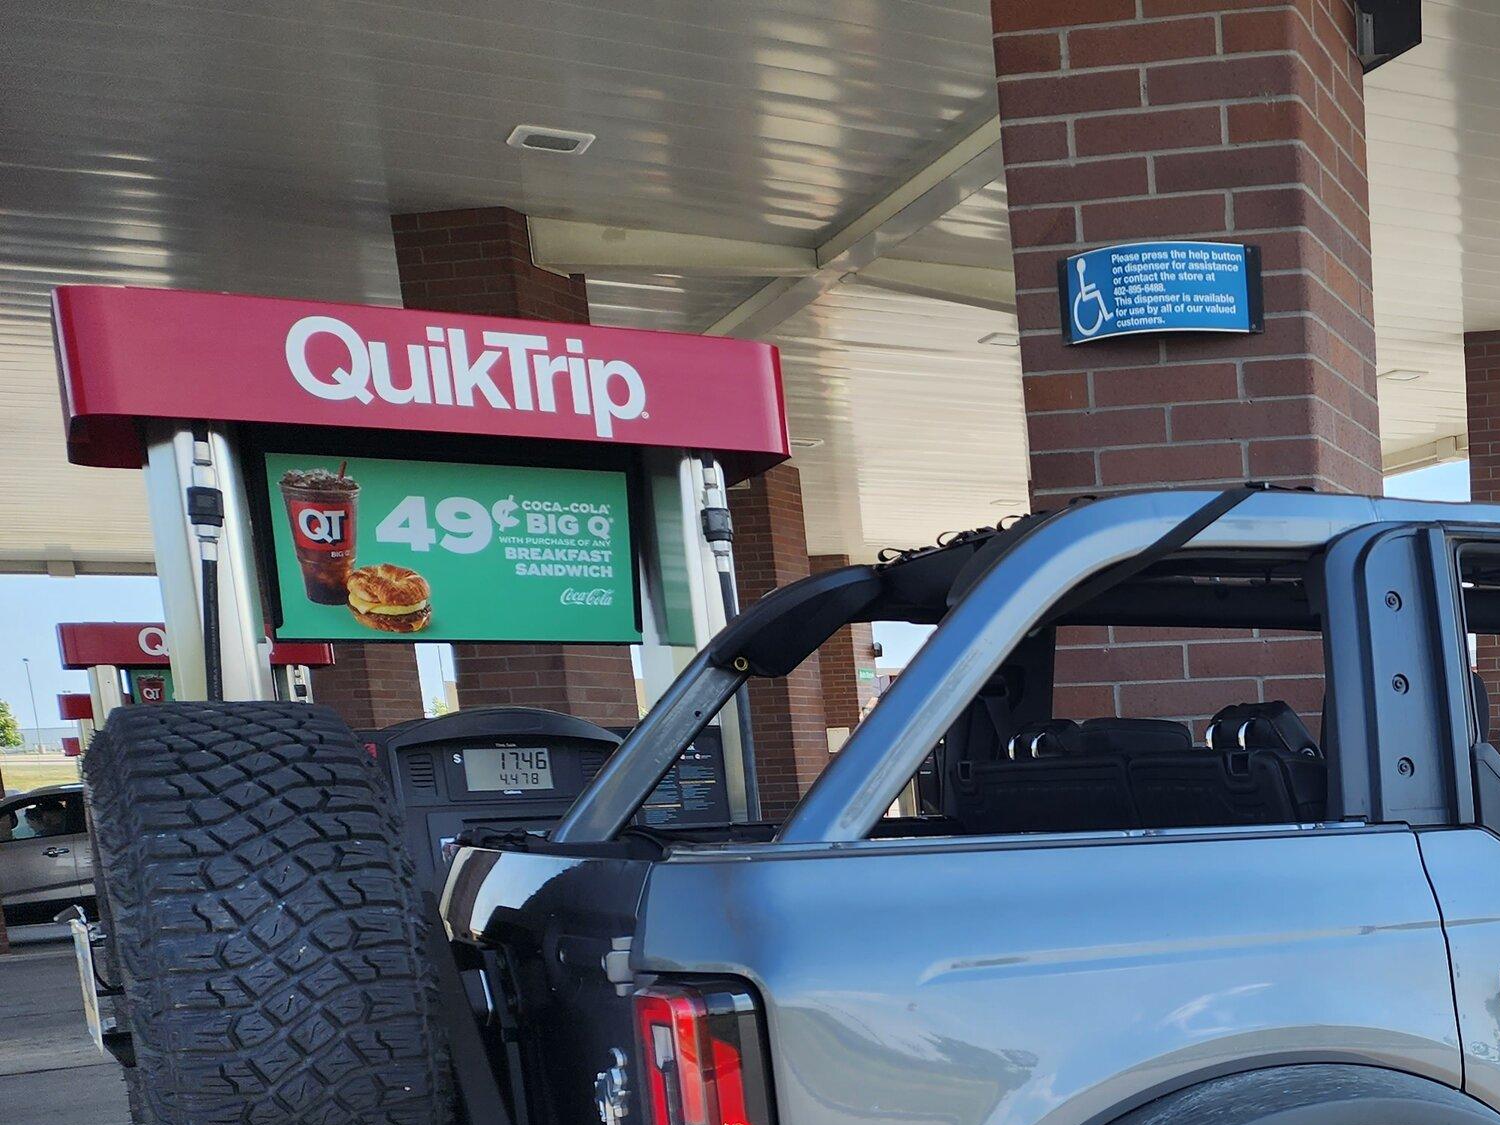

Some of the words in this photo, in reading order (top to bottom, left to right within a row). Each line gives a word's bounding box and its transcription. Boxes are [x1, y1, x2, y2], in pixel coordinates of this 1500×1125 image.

[1111, 253, 1139, 263] Please
[1142, 252, 1168, 261] press
[1171, 250, 1186, 259] the
[1189, 250, 1209, 260] help
[1212, 251, 1241, 261] button
[1125, 263, 1169, 273] dispenser
[1172, 260, 1185, 269] for
[1188, 261, 1238, 271] assistance
[1113, 277, 1121, 285] or
[1124, 272, 1157, 284] contact
[1160, 272, 1175, 280] the
[1178, 272, 1203, 280] store
[1206, 273, 1215, 281] at
[1114, 297, 1132, 306] This
[1134, 294, 1180, 304] dispenser
[1183, 293, 1190, 301] is
[1193, 293, 1234, 303] available
[1116, 308, 1127, 317] for
[1129, 307, 1145, 315] use
[1147, 305, 1158, 315] by
[1161, 303, 1172, 313] all
[1174, 303, 1184, 312] of
[1187, 305, 1203, 313] our
[1206, 304, 1236, 314] valued
[1117, 317, 1165, 328] customers.
[285, 315, 647, 438] QuikTrip
[521, 500, 610, 515] COCA-COLA
[298, 508, 346, 543] QT
[526, 512, 580, 536] BIG
[587, 516, 611, 540] Q
[498, 536, 524, 544] WITH
[525, 537, 577, 546] PURCHASE
[577, 539, 591, 547] OF
[505, 546, 612, 563] BREAKFAST
[515, 562, 613, 578] SANDWICH
[501, 751, 547, 770] 17.46
[500, 772, 539, 785] 4.478
